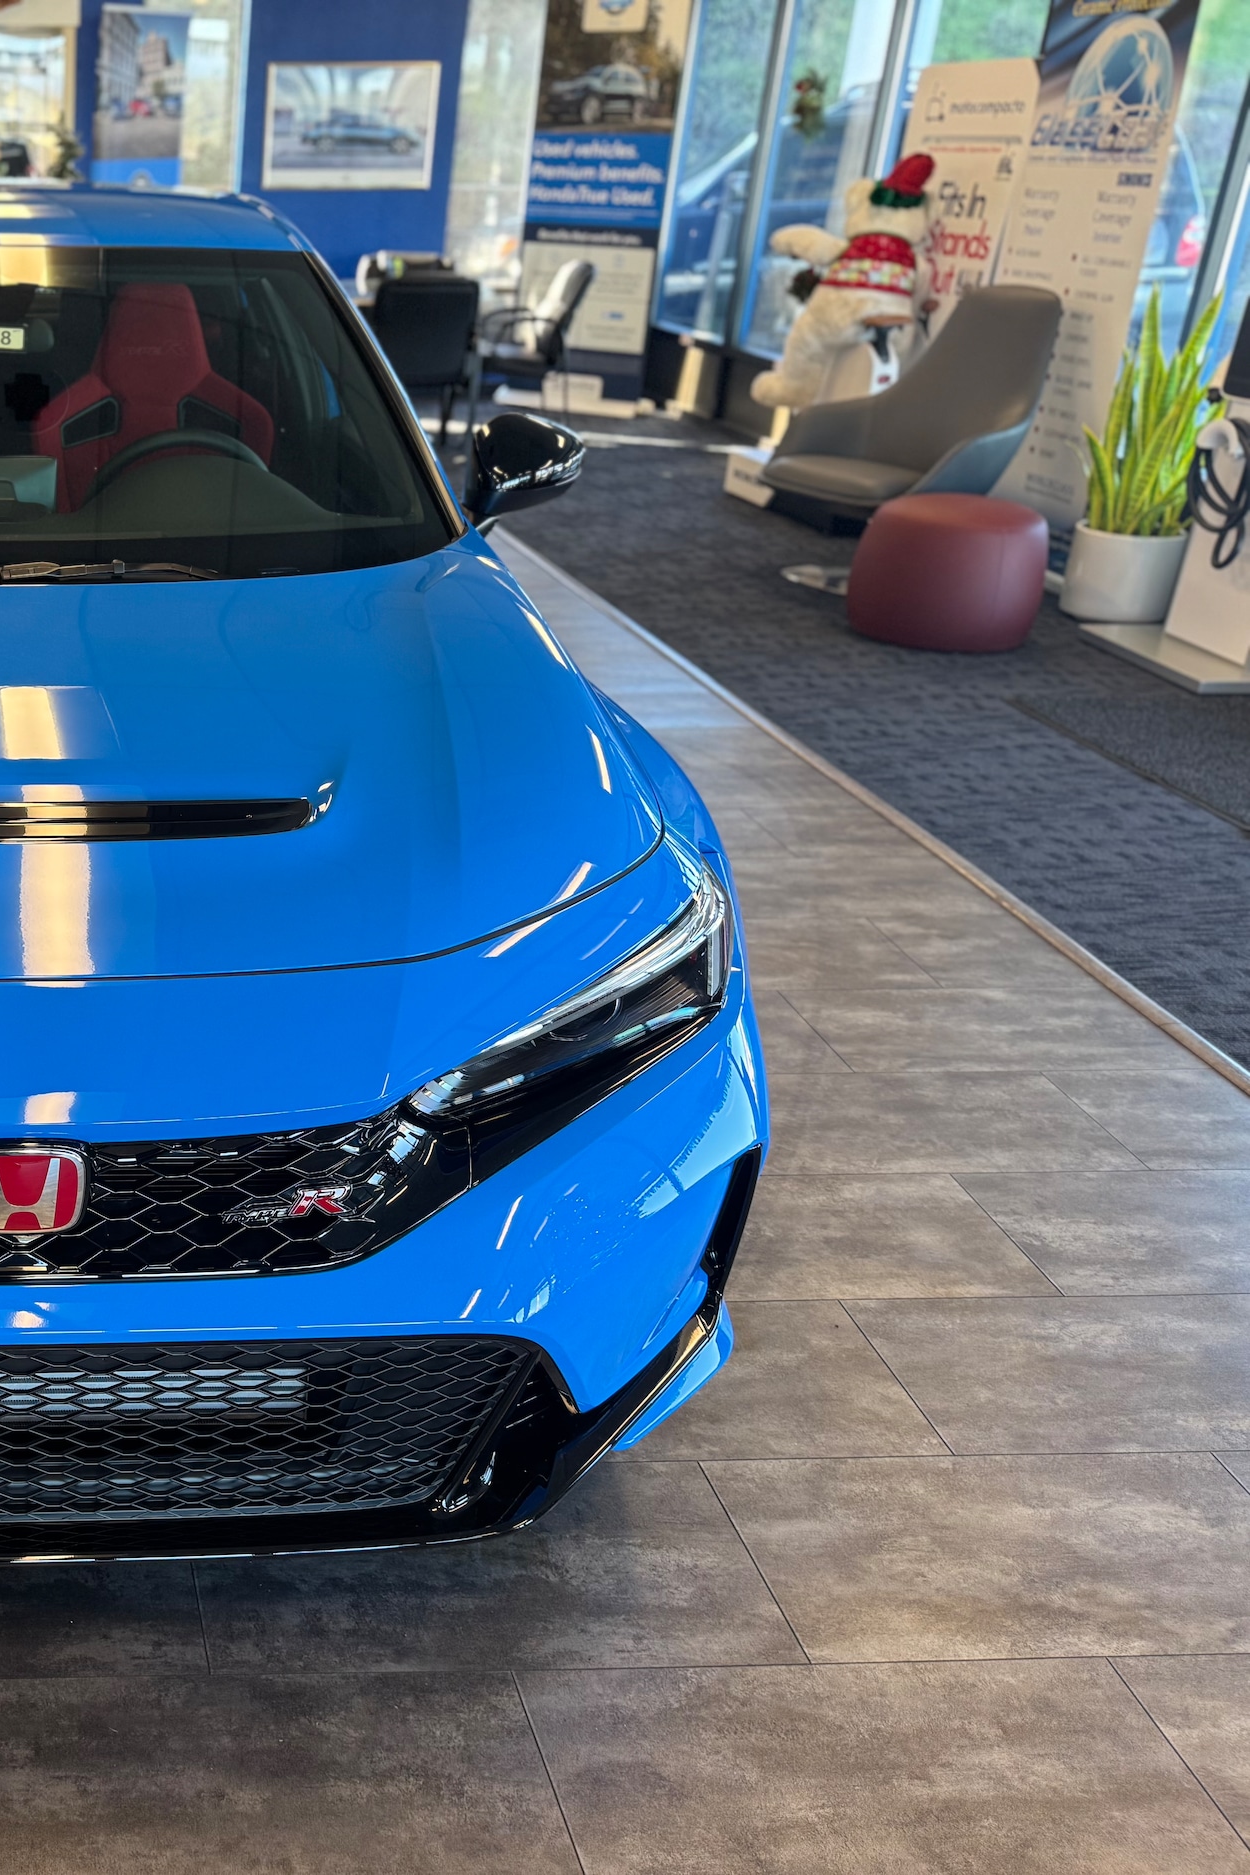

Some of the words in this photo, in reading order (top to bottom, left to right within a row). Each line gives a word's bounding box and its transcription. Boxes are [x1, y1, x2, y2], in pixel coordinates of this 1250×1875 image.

[950, 102, 1025, 118] motocompacto
[533, 138, 574, 158] Used
[574, 138, 639, 159] vehicles.
[532, 160, 596, 181] Premium
[599, 162, 664, 183] benefits.
[611, 186, 655, 206] Used.
[287, 1185, 350, 1217] R
